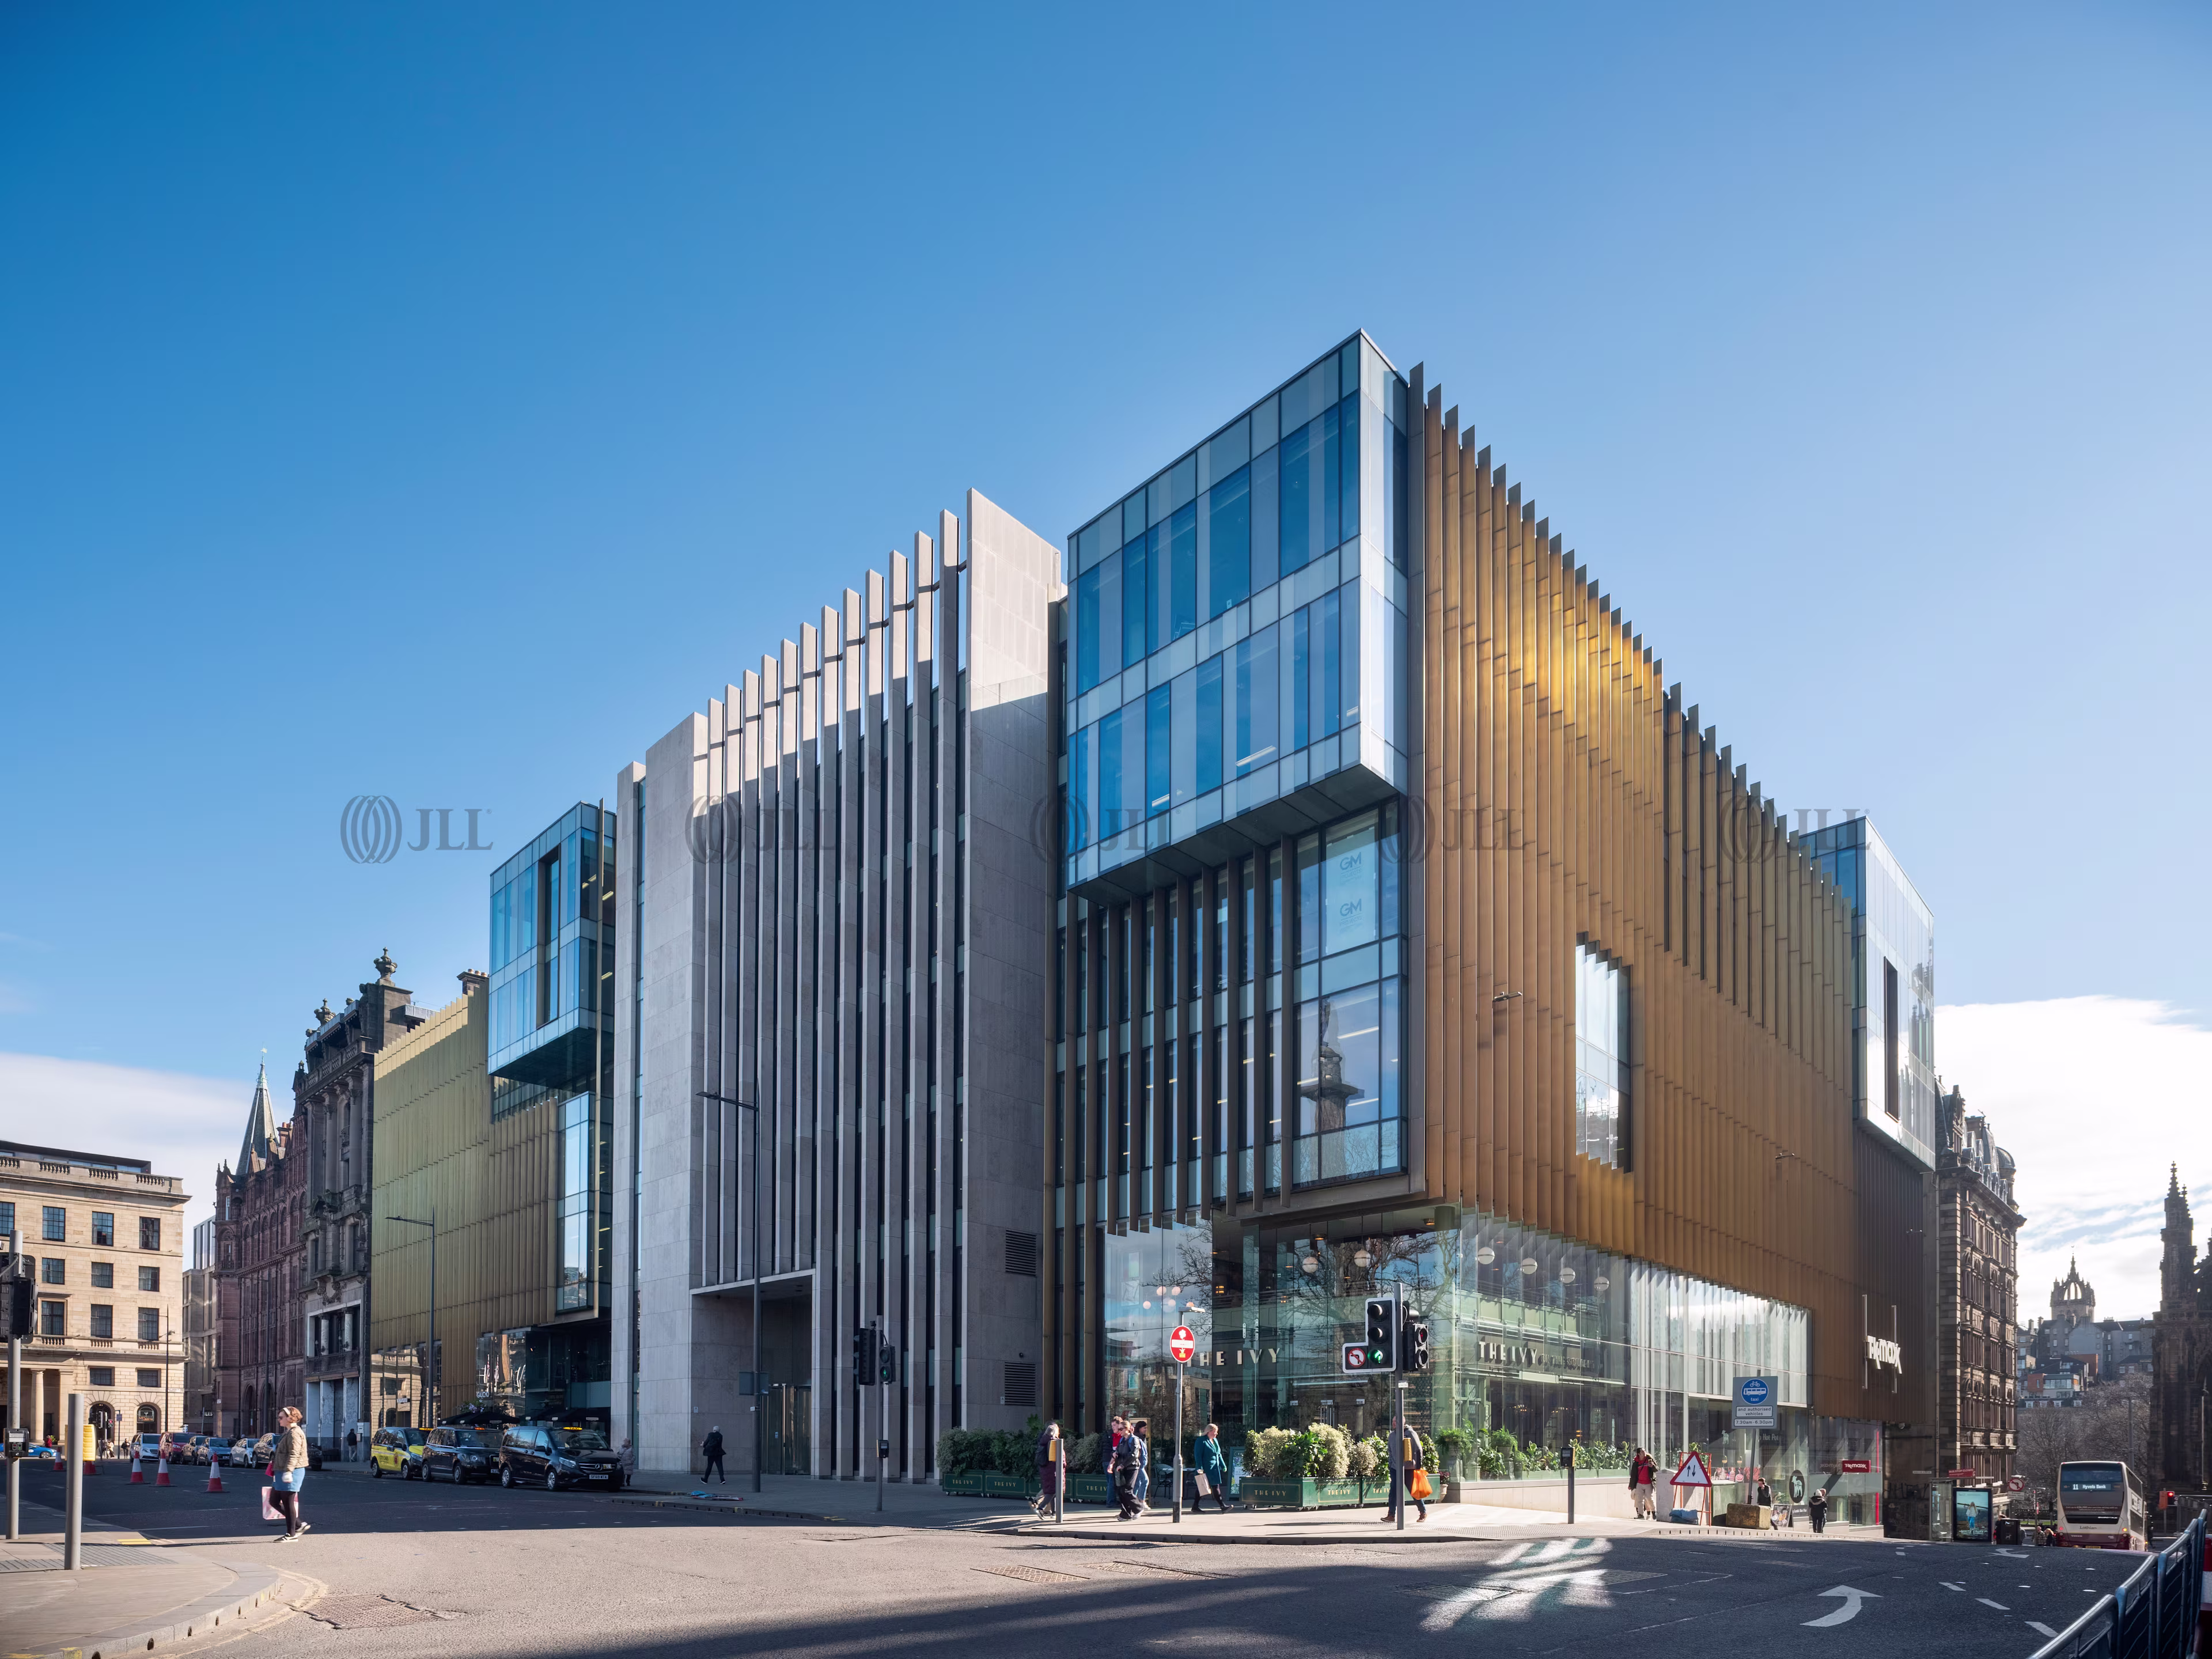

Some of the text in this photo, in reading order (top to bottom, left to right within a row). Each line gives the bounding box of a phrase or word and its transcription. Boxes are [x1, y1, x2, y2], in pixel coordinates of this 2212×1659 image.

[1339, 851, 1362, 870] GM
[1339, 898, 1362, 916] GM
[1237, 1347, 1281, 1365] IVY
[1479, 1341, 1505, 1360] THE
[1512, 1346, 1537, 1364] IVY
[1551, 1355, 1566, 1365] THE
